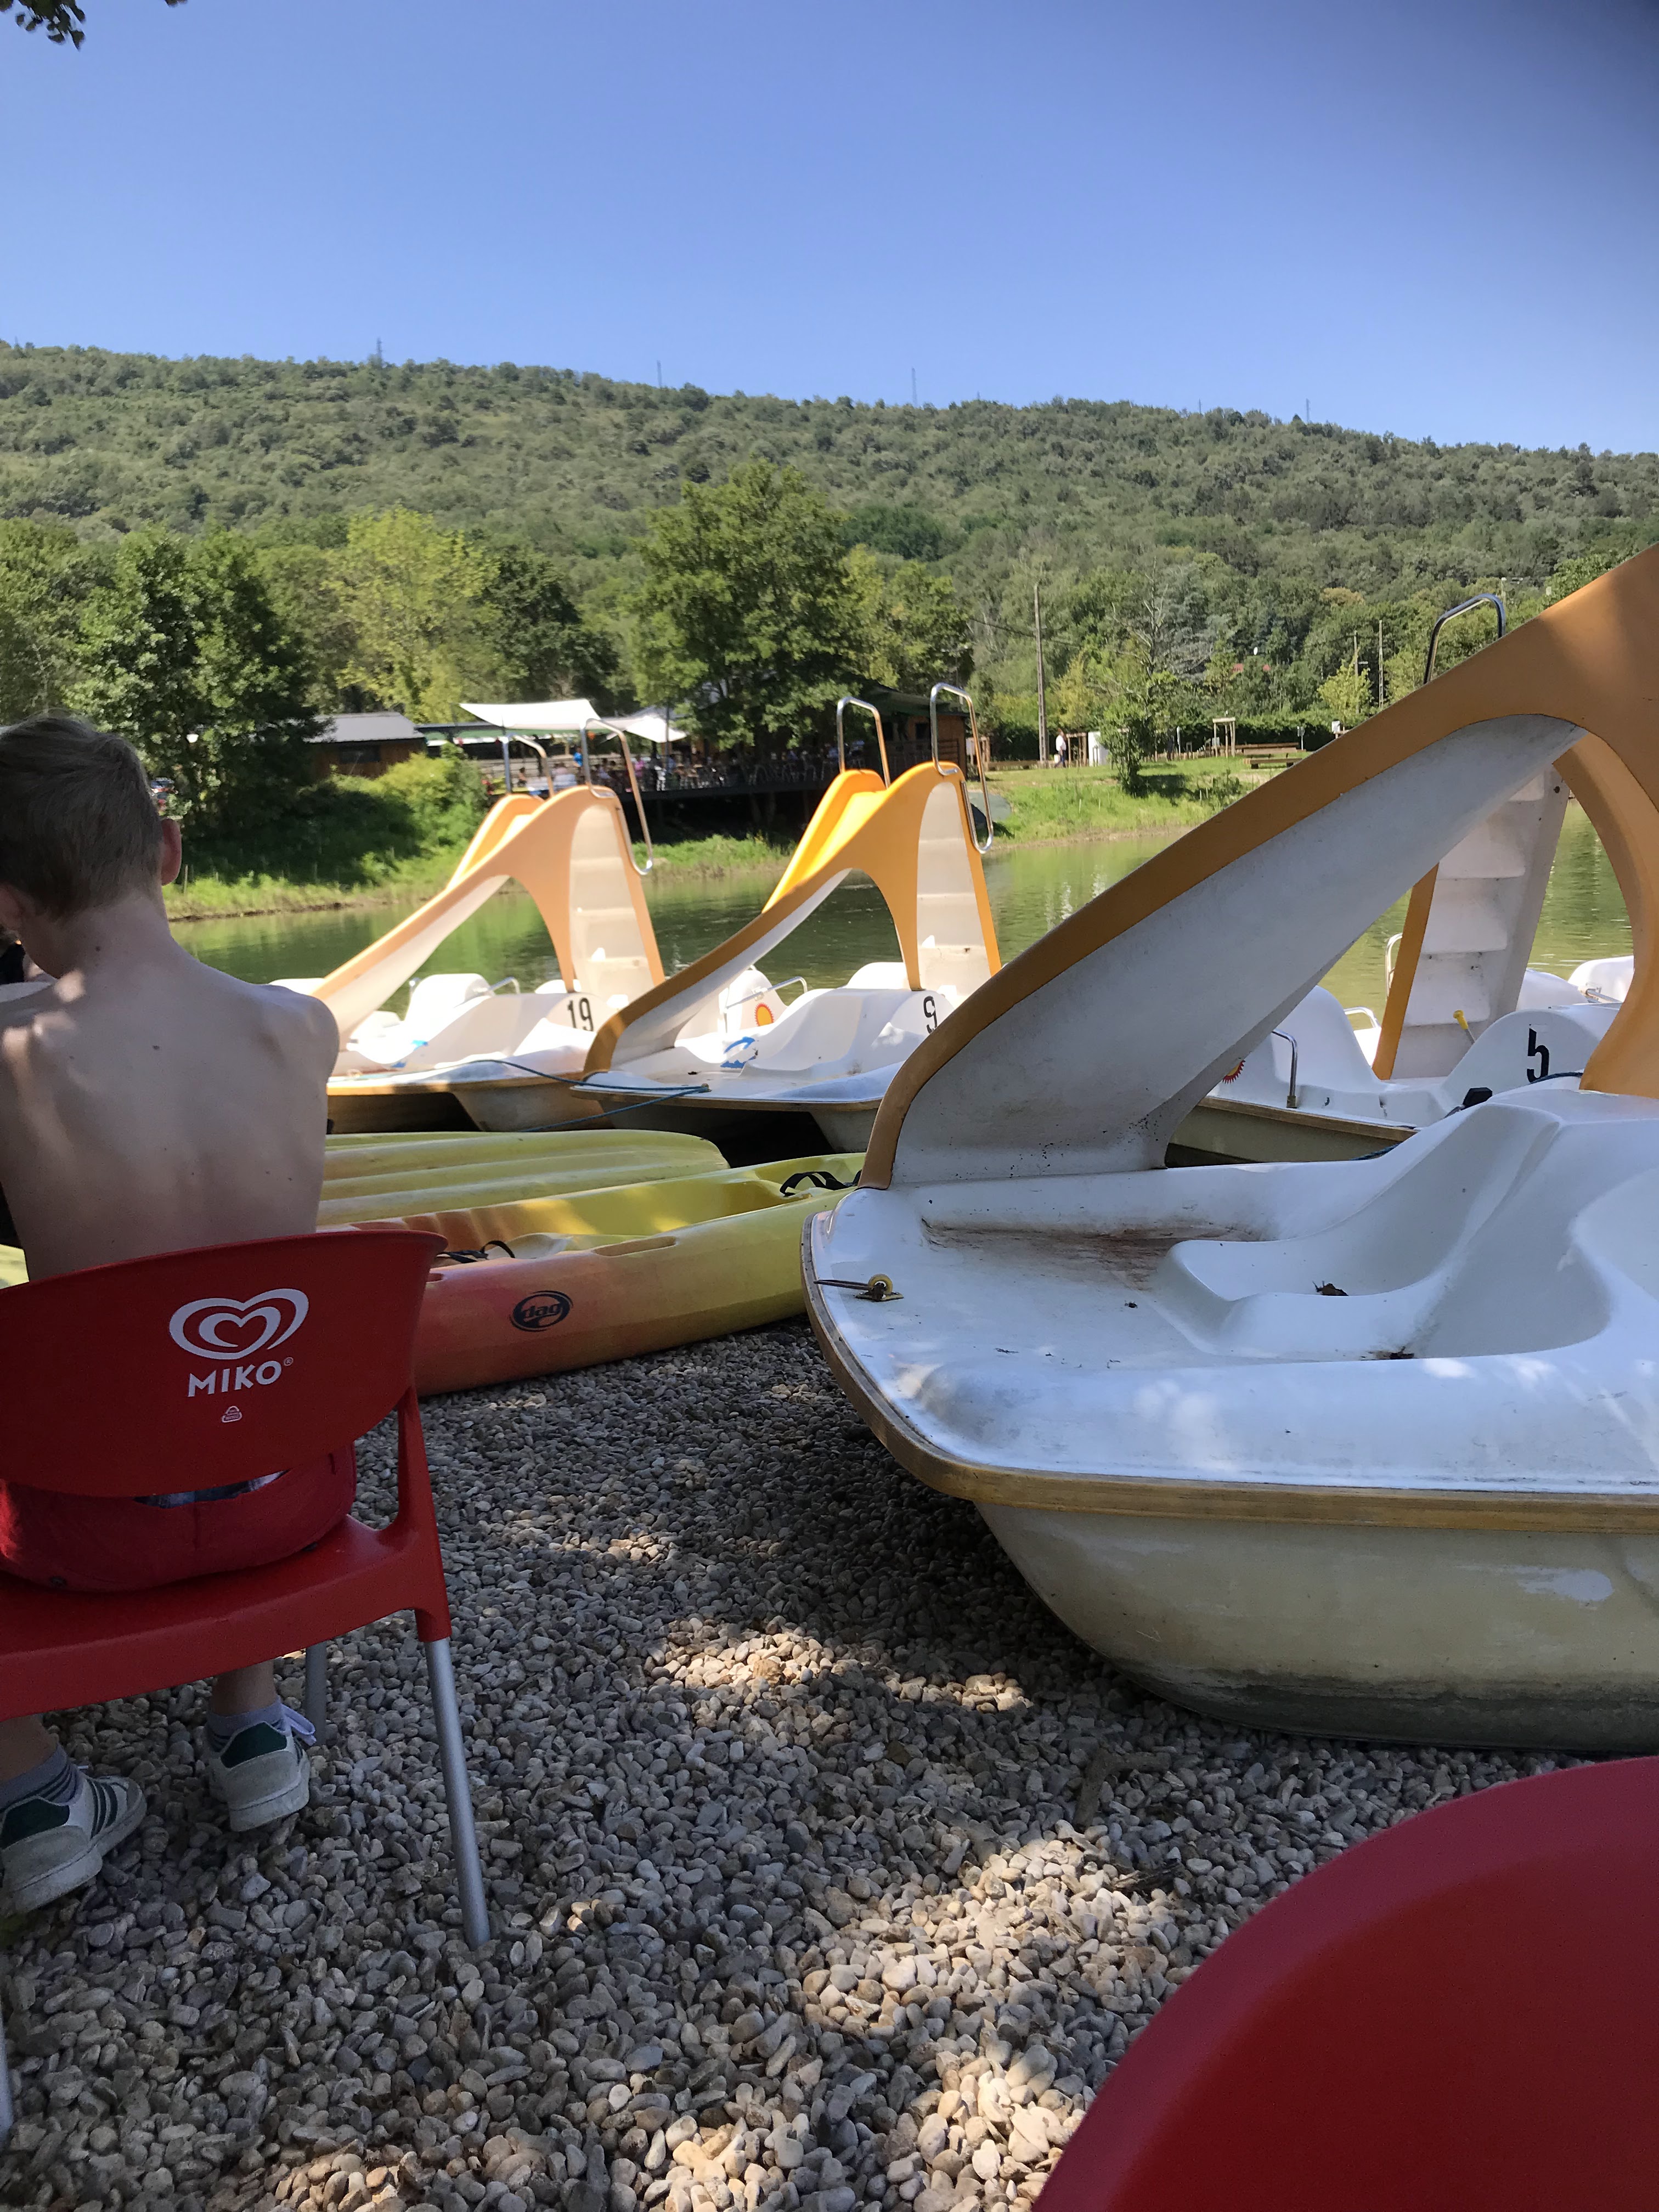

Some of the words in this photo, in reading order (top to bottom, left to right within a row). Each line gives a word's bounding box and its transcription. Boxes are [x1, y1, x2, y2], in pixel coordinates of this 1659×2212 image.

[567, 997, 594, 1032] 19
[923, 995, 938, 1034] 9
[1527, 1027, 1550, 1084] 5
[187, 1361, 282, 1397] MIKO
